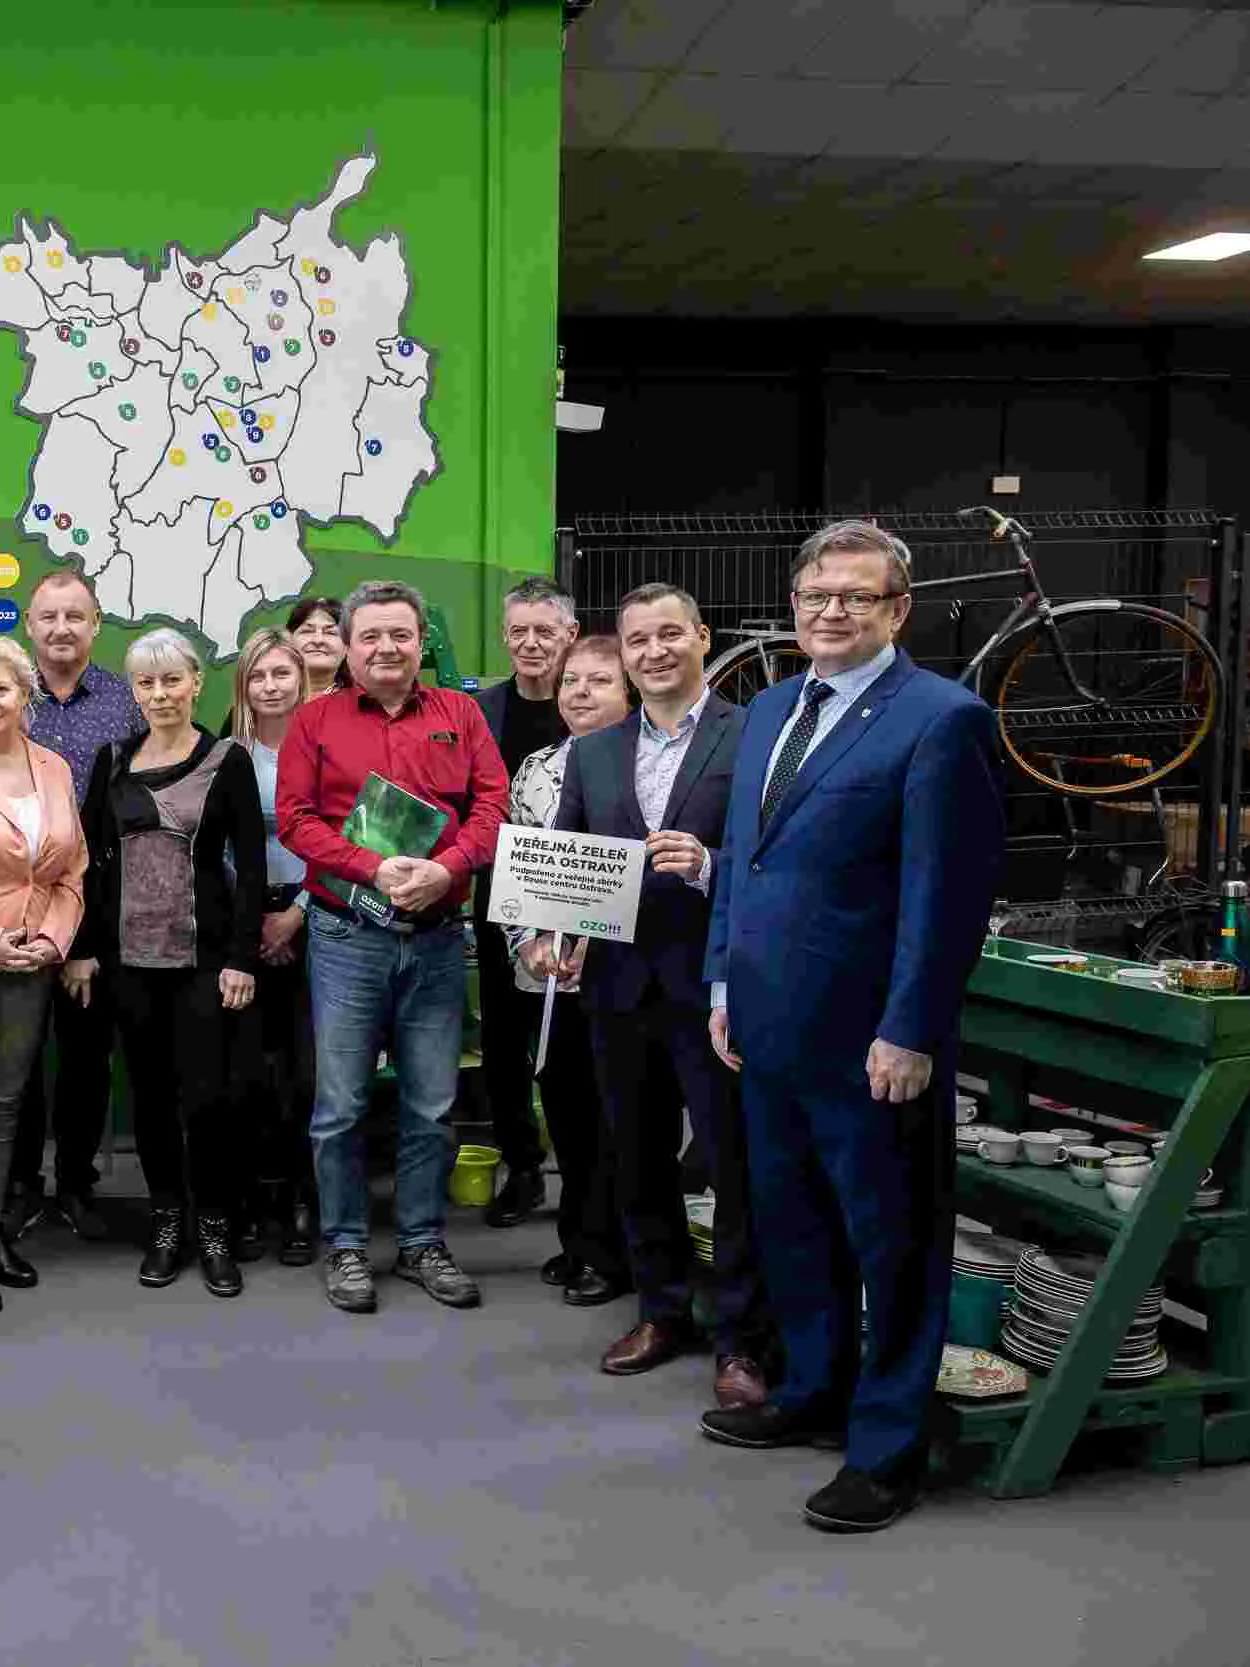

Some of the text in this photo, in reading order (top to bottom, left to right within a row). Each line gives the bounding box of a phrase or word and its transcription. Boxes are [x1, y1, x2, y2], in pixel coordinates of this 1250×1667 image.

[513, 836, 628, 861] VEŘEJNÁ ZELEŇ
[510, 849, 627, 875] MĚSTA OSTRAVY
[550, 880, 578, 890] centru
